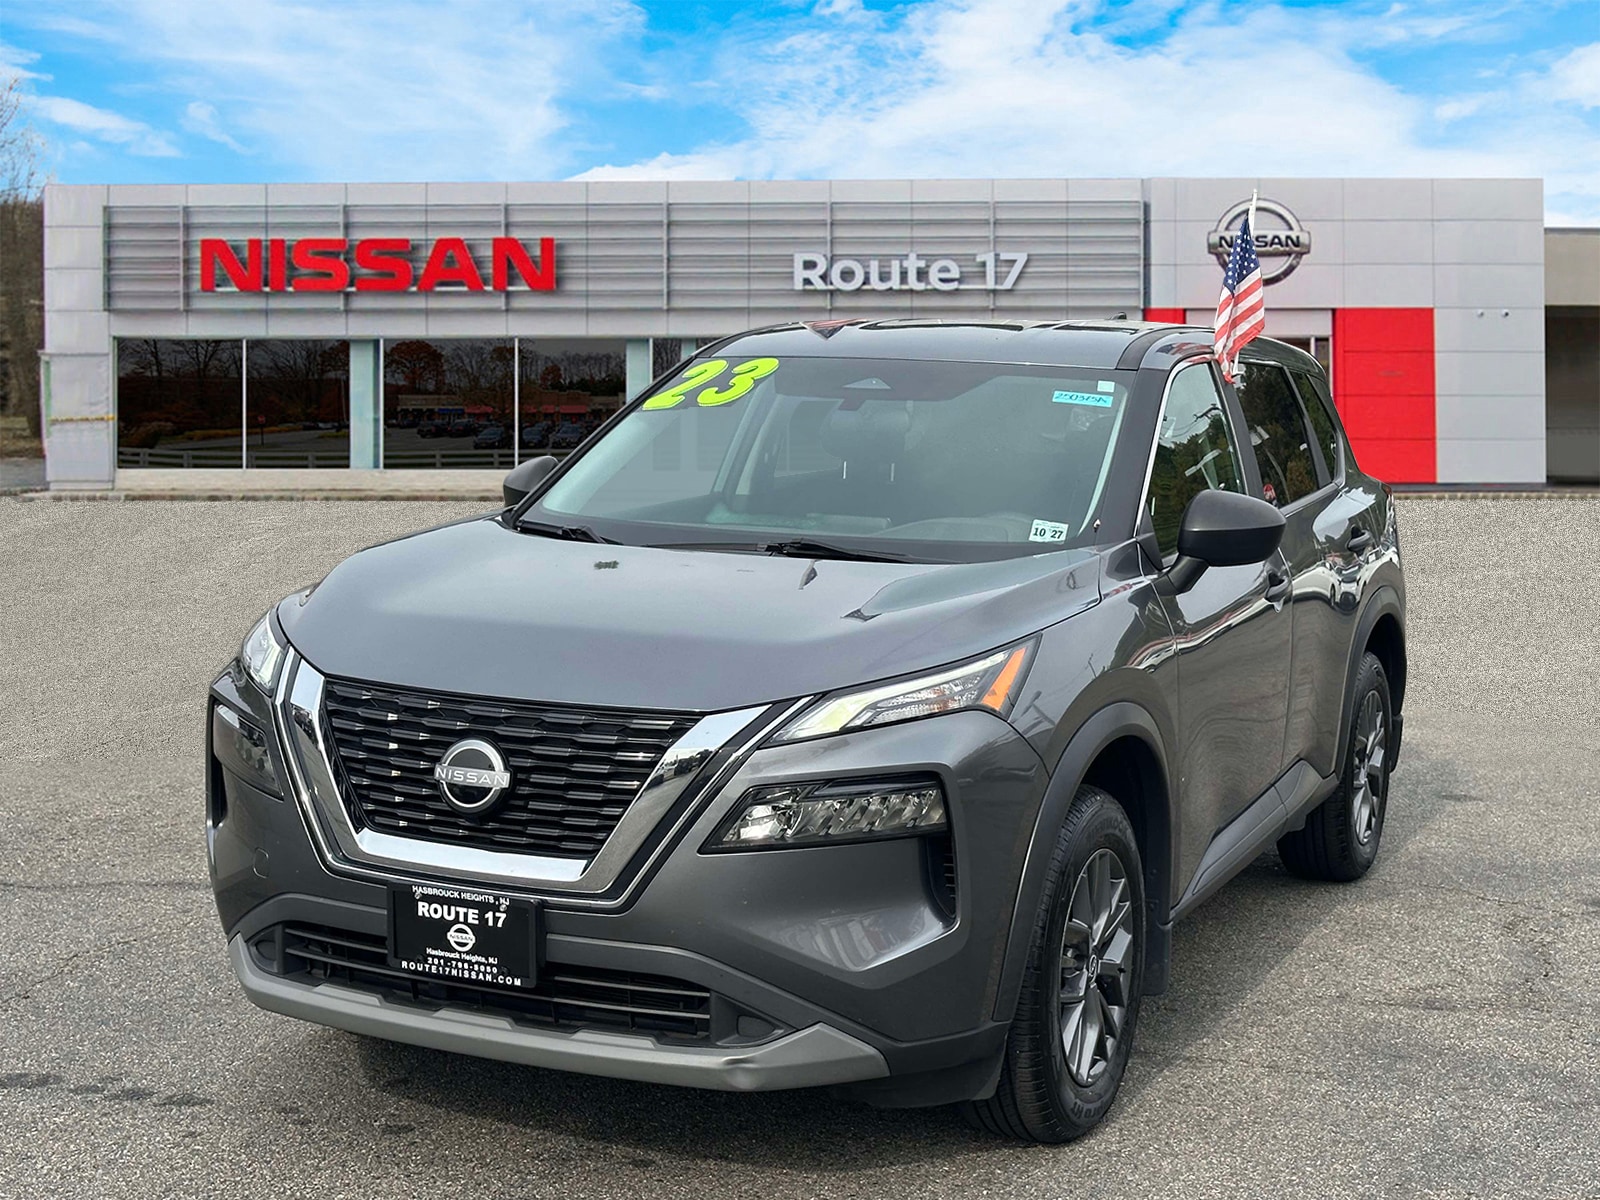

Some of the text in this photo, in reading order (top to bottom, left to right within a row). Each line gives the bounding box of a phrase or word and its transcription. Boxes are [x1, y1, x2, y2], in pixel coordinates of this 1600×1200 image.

[1219, 235, 1300, 248] NSAN
[200, 237, 556, 291] NISSAN
[793, 252, 1029, 291] Route 17
[642, 357, 779, 411] 23
[1033, 527, 1063, 539] 10 27
[435, 767, 507, 786] NISSAN
[412, 885, 460, 898] HASBROUCK
[500, 897, 509, 906] NJ
[417, 901, 507, 928] ROUTE 17
[426, 947, 460, 959] Hasbrouck
[401, 961, 522, 986] ROUTE17NISSAN.COM
